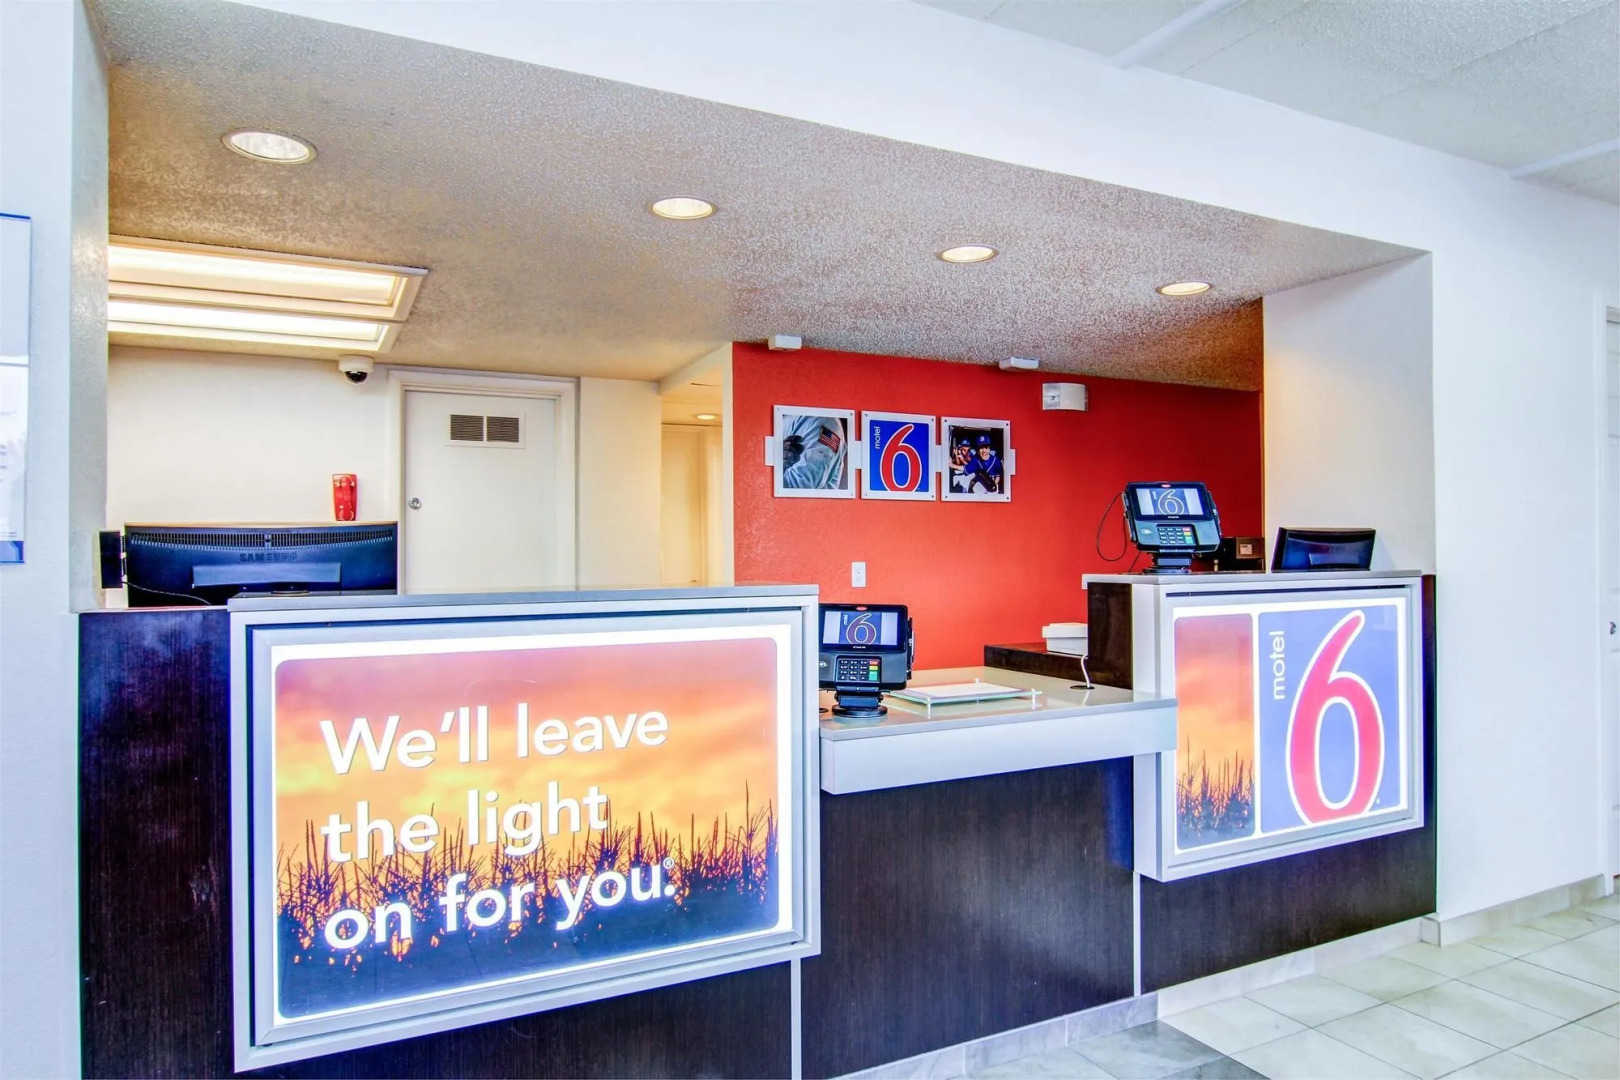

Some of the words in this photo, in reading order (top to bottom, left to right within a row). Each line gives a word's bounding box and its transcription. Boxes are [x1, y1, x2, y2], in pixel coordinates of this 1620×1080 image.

[881, 424, 922, 492] 6
[515, 702, 670, 759] leave
[1269, 630, 1286, 700] motel
[1285, 609, 1386, 826] 6
[319, 800, 440, 864] the
[467, 780, 609, 857] light
[323, 900, 413, 950] on
[438, 873, 535, 932] for
